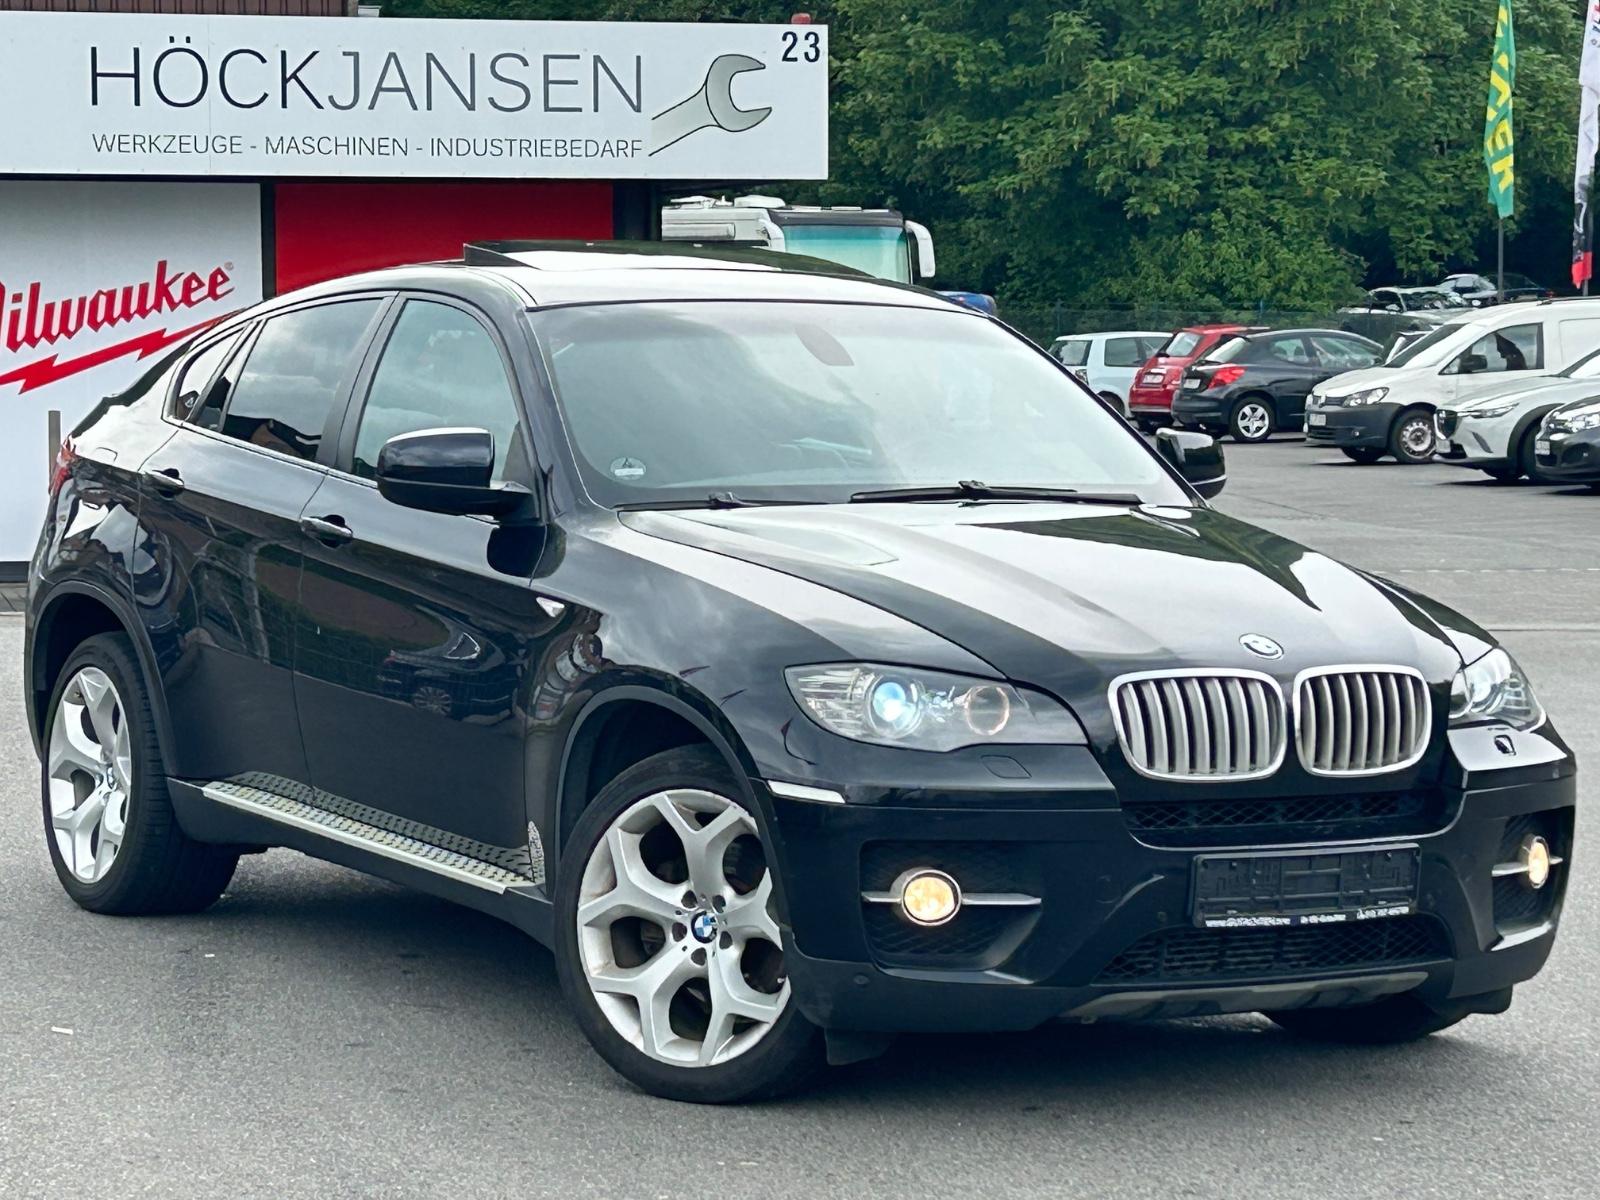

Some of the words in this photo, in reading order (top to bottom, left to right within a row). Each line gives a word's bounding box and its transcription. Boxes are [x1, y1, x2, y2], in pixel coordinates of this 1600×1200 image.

[90, 35, 642, 113] HÖCKJANSEN
[781, 31, 820, 63] 23
[91, 132, 243, 155] WERKZEUGE
[264, 136, 408, 156] MASCHINEN
[430, 137, 642, 159] INDUSTRIEBEDARF
[0, 260, 235, 353] ilwaukee
